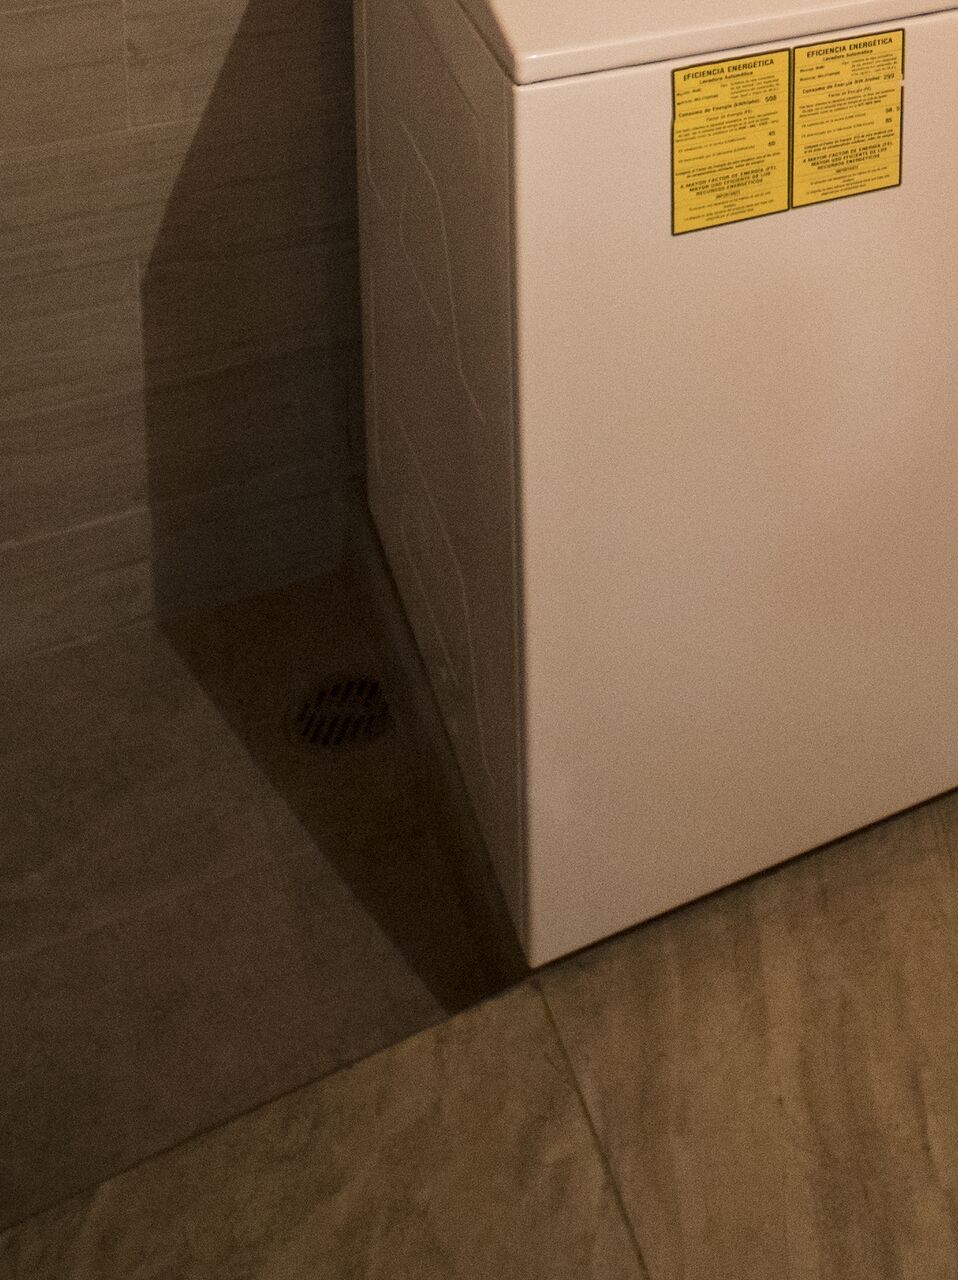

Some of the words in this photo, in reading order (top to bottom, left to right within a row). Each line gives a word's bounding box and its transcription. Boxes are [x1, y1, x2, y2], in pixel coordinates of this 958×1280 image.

[806, 45, 847, 58] EFICIENCIA
[849, 37, 893, 51] ENERGÉTICA
[683, 66, 725, 81] EFICIENCIA
[727, 58, 775, 73] ENERGÉTICA
